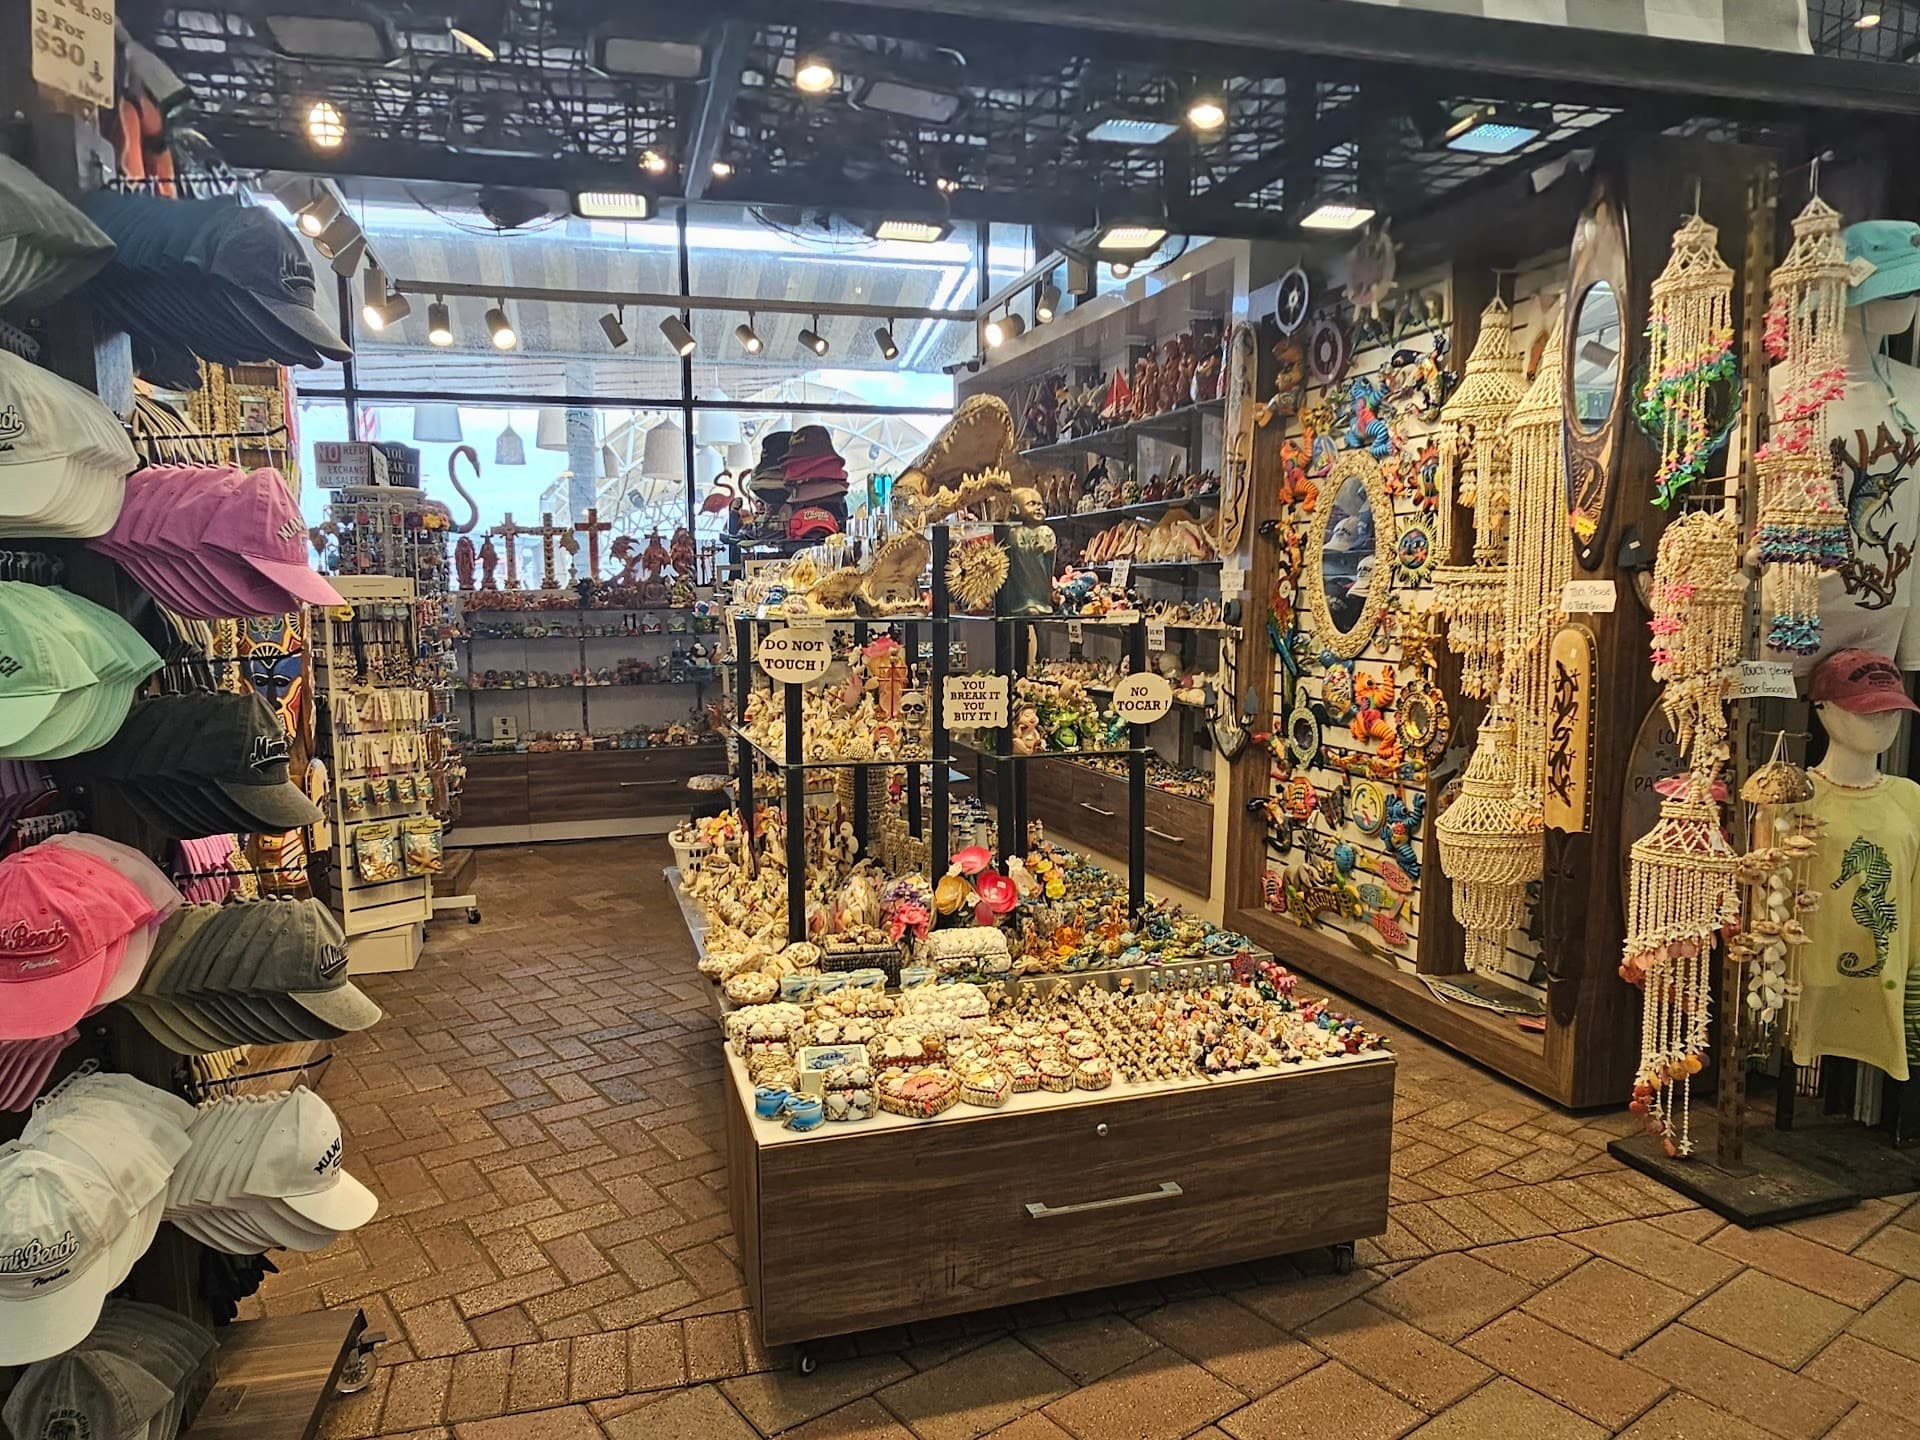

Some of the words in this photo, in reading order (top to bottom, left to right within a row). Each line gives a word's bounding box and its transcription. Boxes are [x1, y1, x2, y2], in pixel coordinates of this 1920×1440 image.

[36, 8, 48, 24] 3
[53, 14, 85, 40] For
[35, 27, 85, 67] $30
[319, 444, 340, 461] NO
[385, 448, 405, 459] YOU
[765, 640, 788, 650] DO
[791, 640, 824, 652] NOT
[764, 658, 816, 671] TOUCH
[962, 681, 985, 690] YOU
[950, 692, 987, 700] BREAK
[989, 691, 1000, 700] IT
[1130, 687, 1149, 697] NO
[963, 702, 985, 710] YOU
[1117, 700, 1161, 711] TOCAR
[954, 712, 976, 721] BUY
[978, 712, 991, 721] IT
[11, 919, 70, 950] Beach
[20, 1230, 80, 1270] Beach
